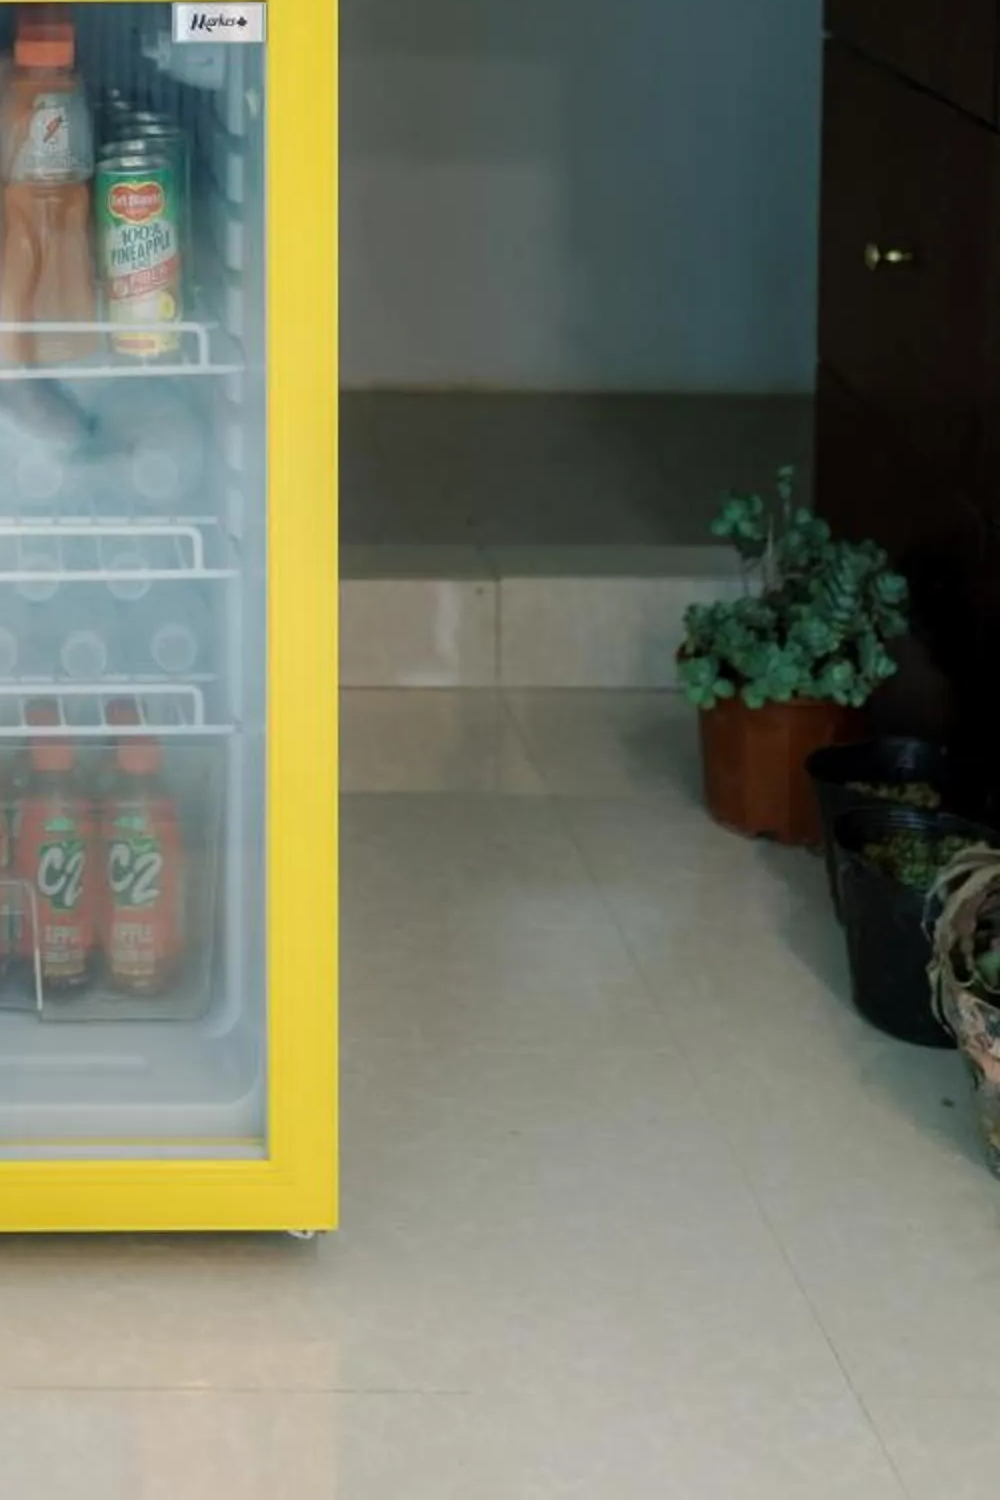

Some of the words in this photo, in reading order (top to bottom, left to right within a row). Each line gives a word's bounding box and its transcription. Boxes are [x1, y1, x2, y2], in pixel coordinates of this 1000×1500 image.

[111, 230, 173, 266] PINEAPPLE
[37, 845, 85, 907] C2
[107, 843, 164, 906] C2
